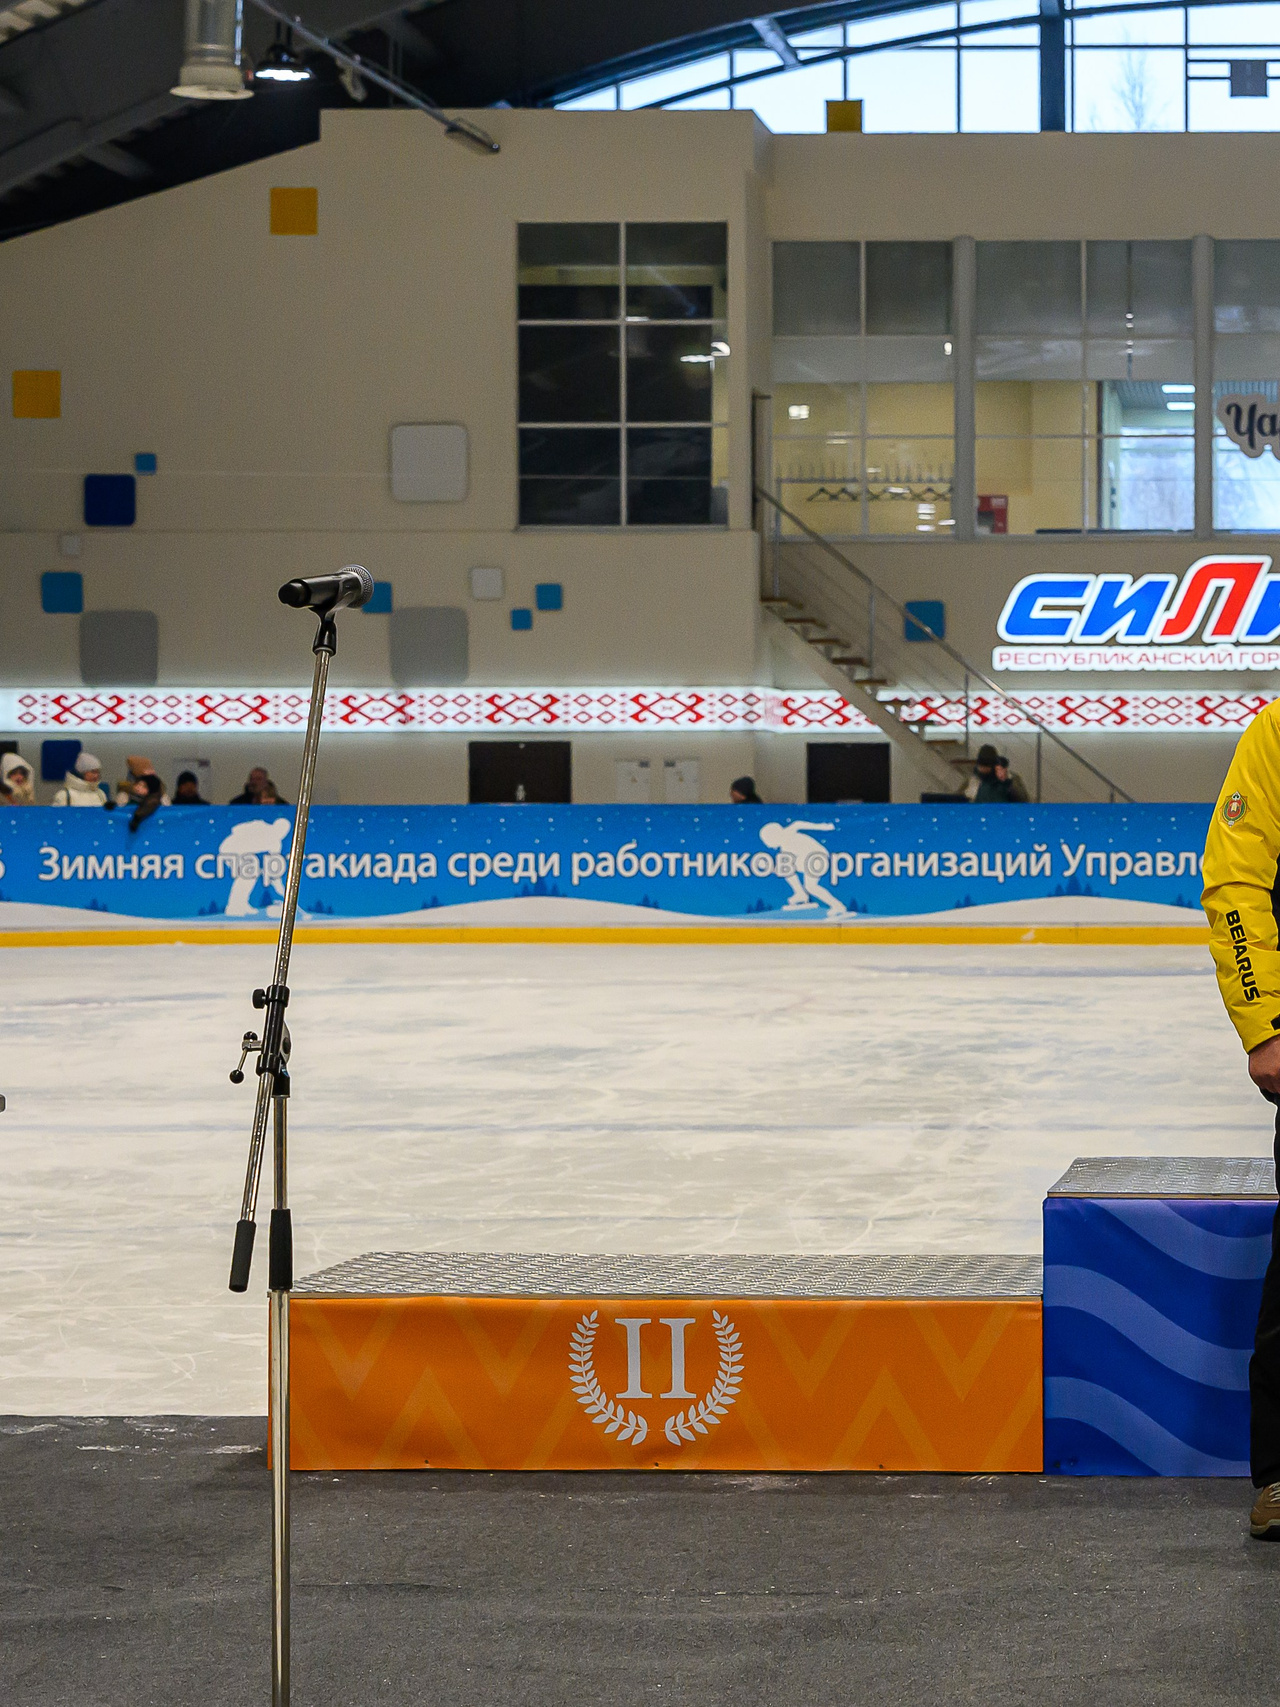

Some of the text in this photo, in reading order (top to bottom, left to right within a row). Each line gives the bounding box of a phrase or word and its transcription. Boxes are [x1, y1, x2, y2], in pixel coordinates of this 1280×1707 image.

[998, 648, 1233, 666] РЕСПУБЛИКАНСКИЙ
[38, 846, 184, 881] Зимняя
[194, 852, 437, 887] спаракиада
[447, 852, 561, 886] среди
[571, 842, 797, 886] работников
[804, 842, 1052, 886] организаций
[1060, 843, 1204, 885] Управл
[614, 1317, 697, 1399] II
